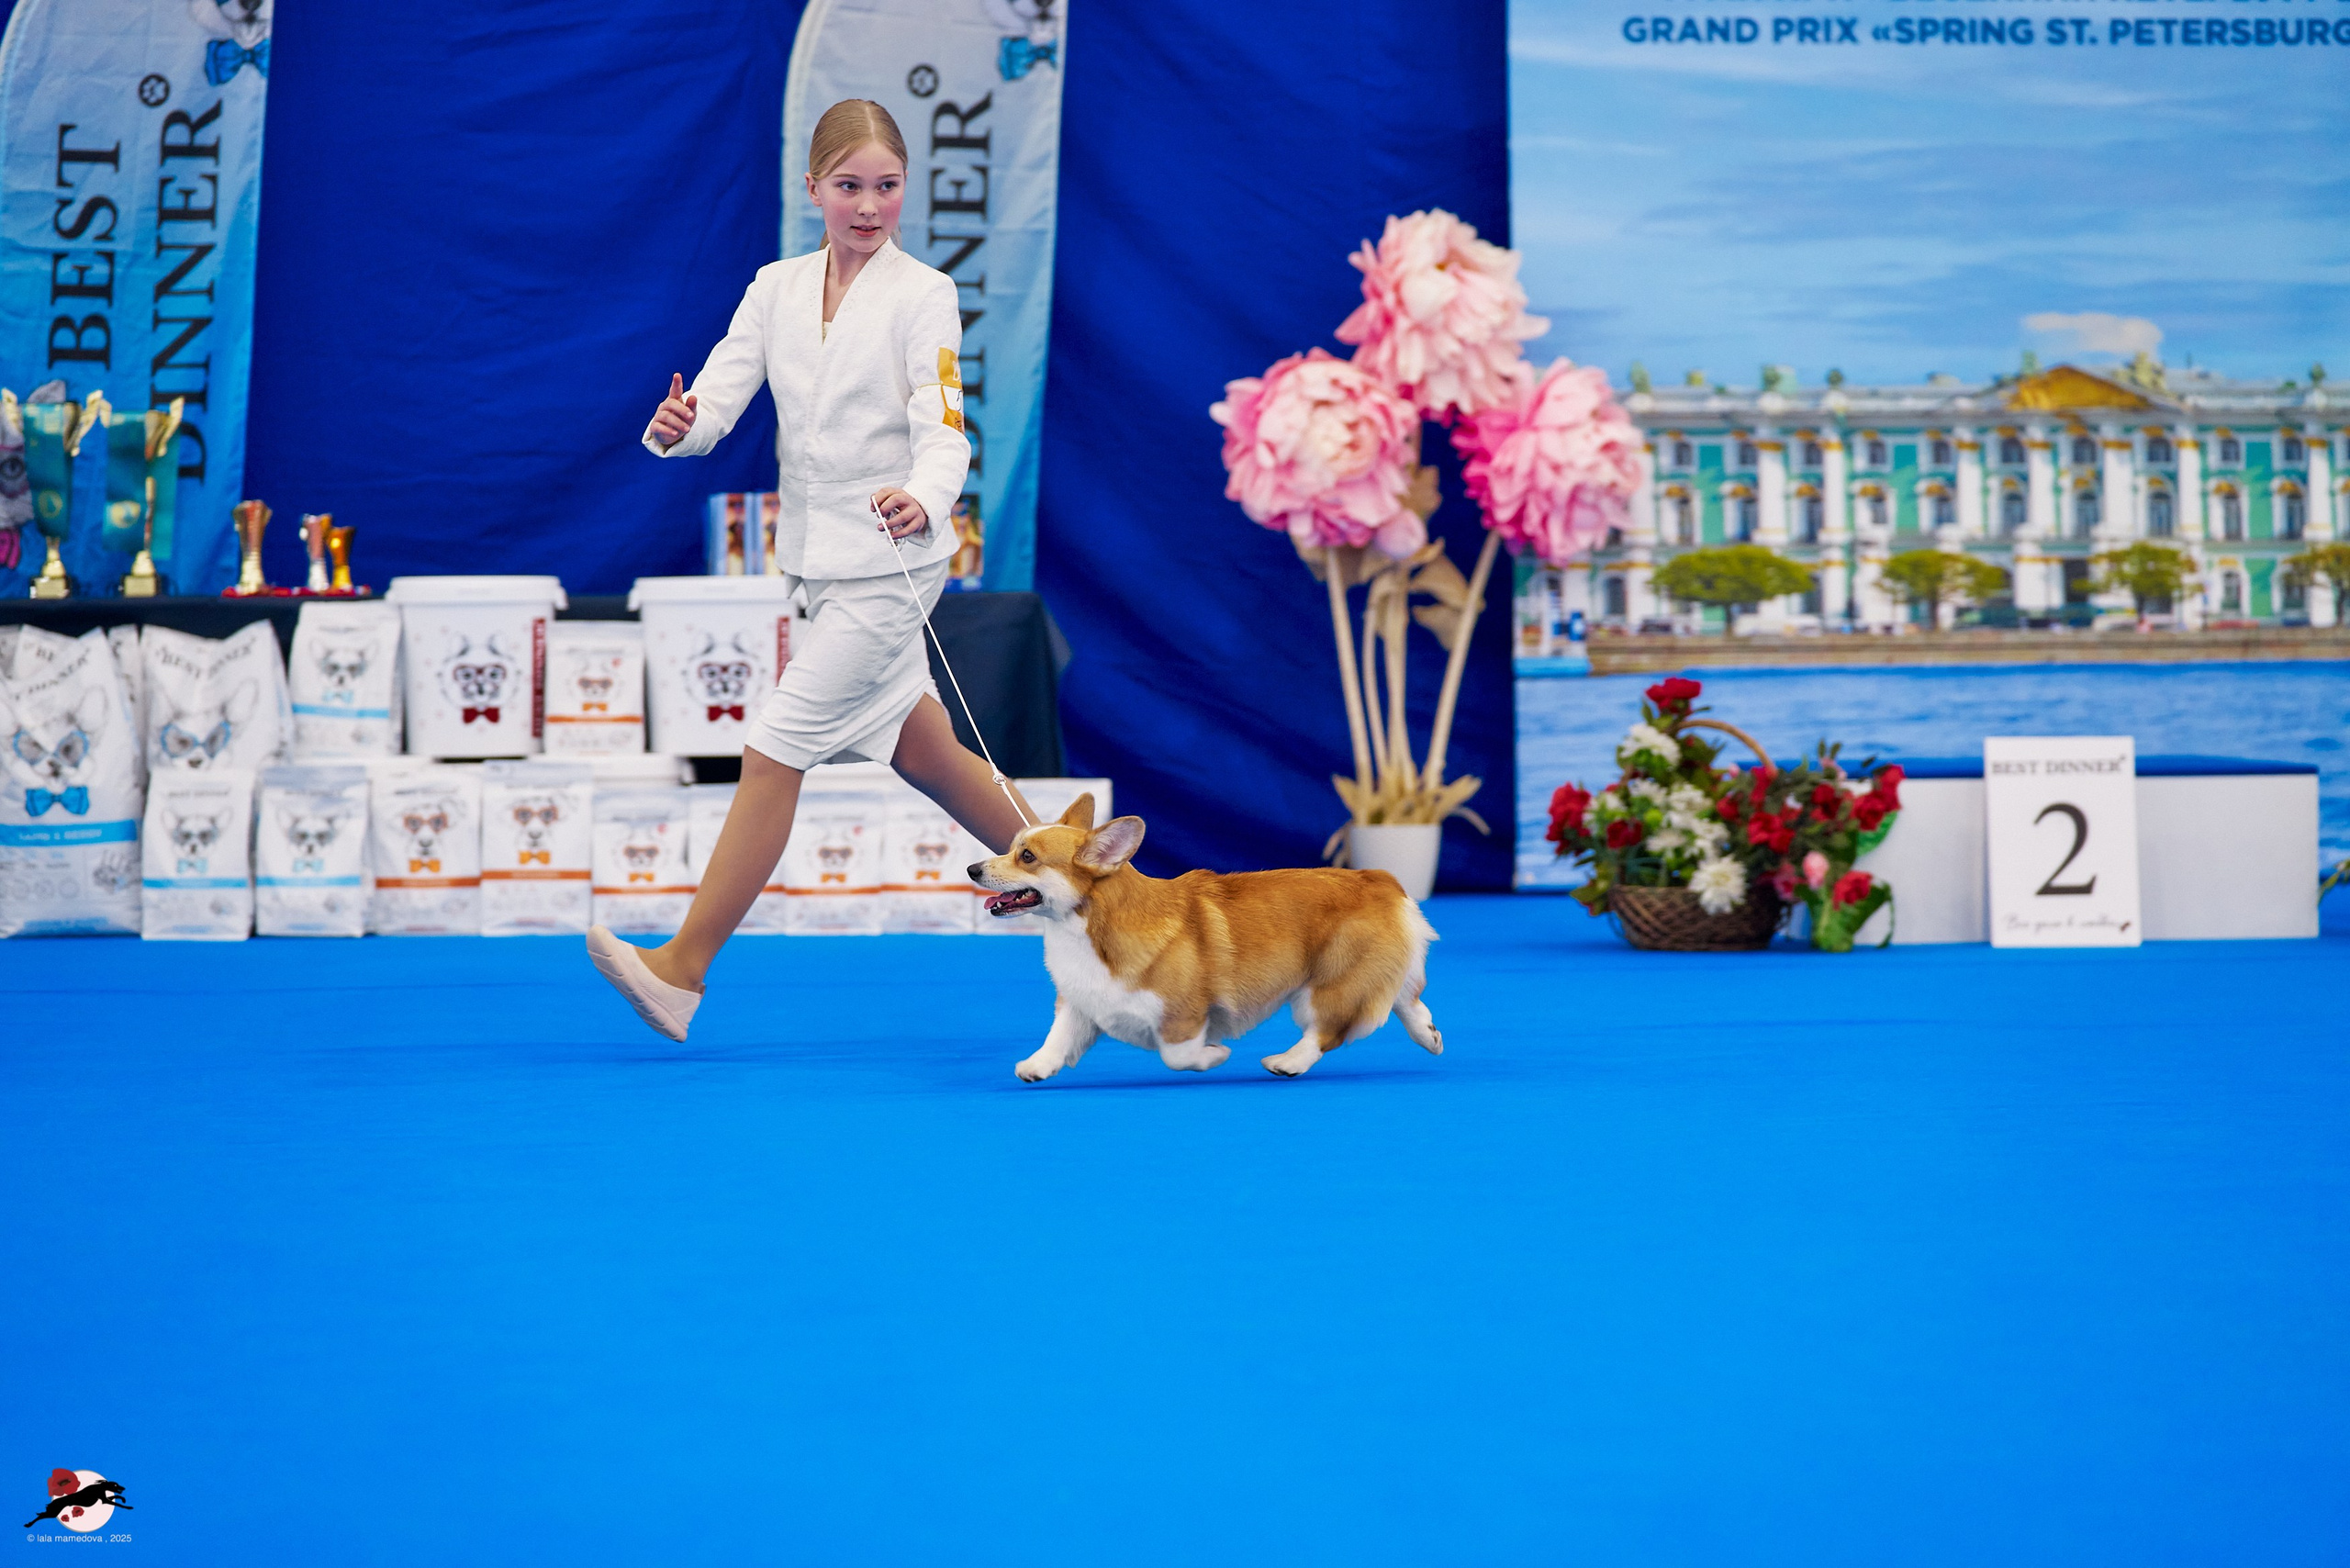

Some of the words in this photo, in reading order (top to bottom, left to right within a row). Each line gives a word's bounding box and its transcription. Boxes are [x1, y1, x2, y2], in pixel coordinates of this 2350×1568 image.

[1622, 17, 1760, 44] GRAND
[1773, 17, 1859, 44] PRIX
[1872, 17, 2035, 45] «SPRING
[2045, 18, 2099, 46] ST.
[48, 123, 121, 371] BEST
[150, 96, 223, 486] DINNER
[1991, 761, 2038, 774] BEST
[2045, 758, 2121, 774] DINNER
[2033, 801, 2097, 896] 2
